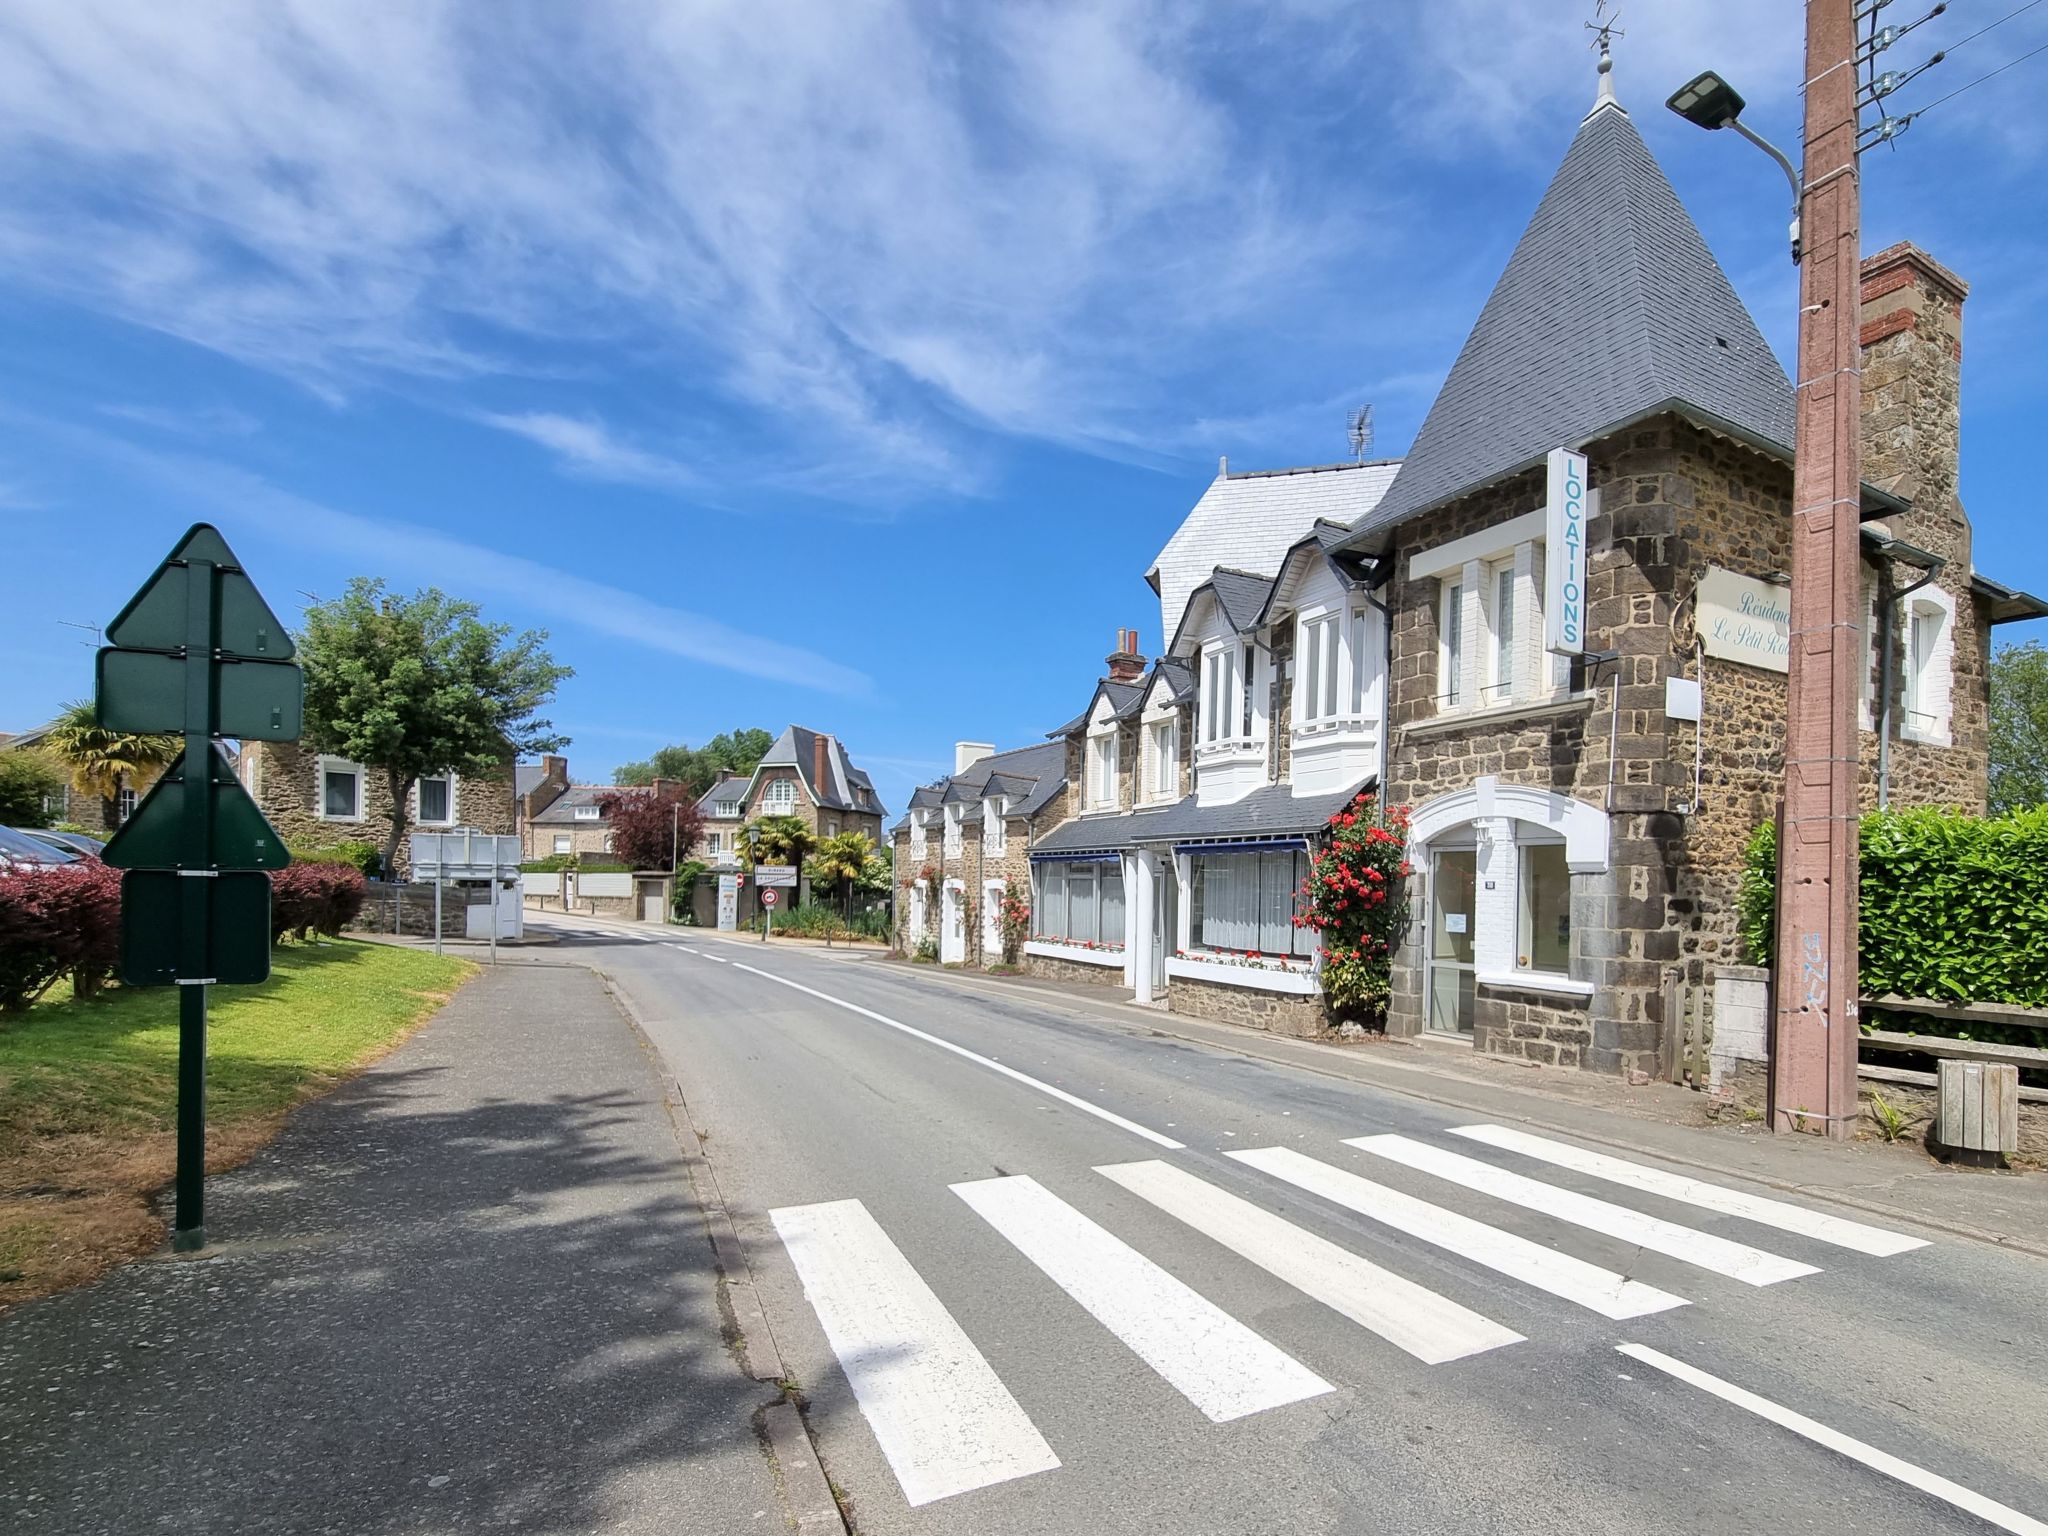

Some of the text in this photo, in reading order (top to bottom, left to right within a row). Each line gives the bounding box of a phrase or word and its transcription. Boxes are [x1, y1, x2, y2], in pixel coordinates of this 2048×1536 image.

[1563, 458, 1582, 644] LOCATIONS
[1737, 591, 1791, 624] Résidenc
[1712, 616, 1731, 642] Le
[1733, 623, 1764, 649] Petit
